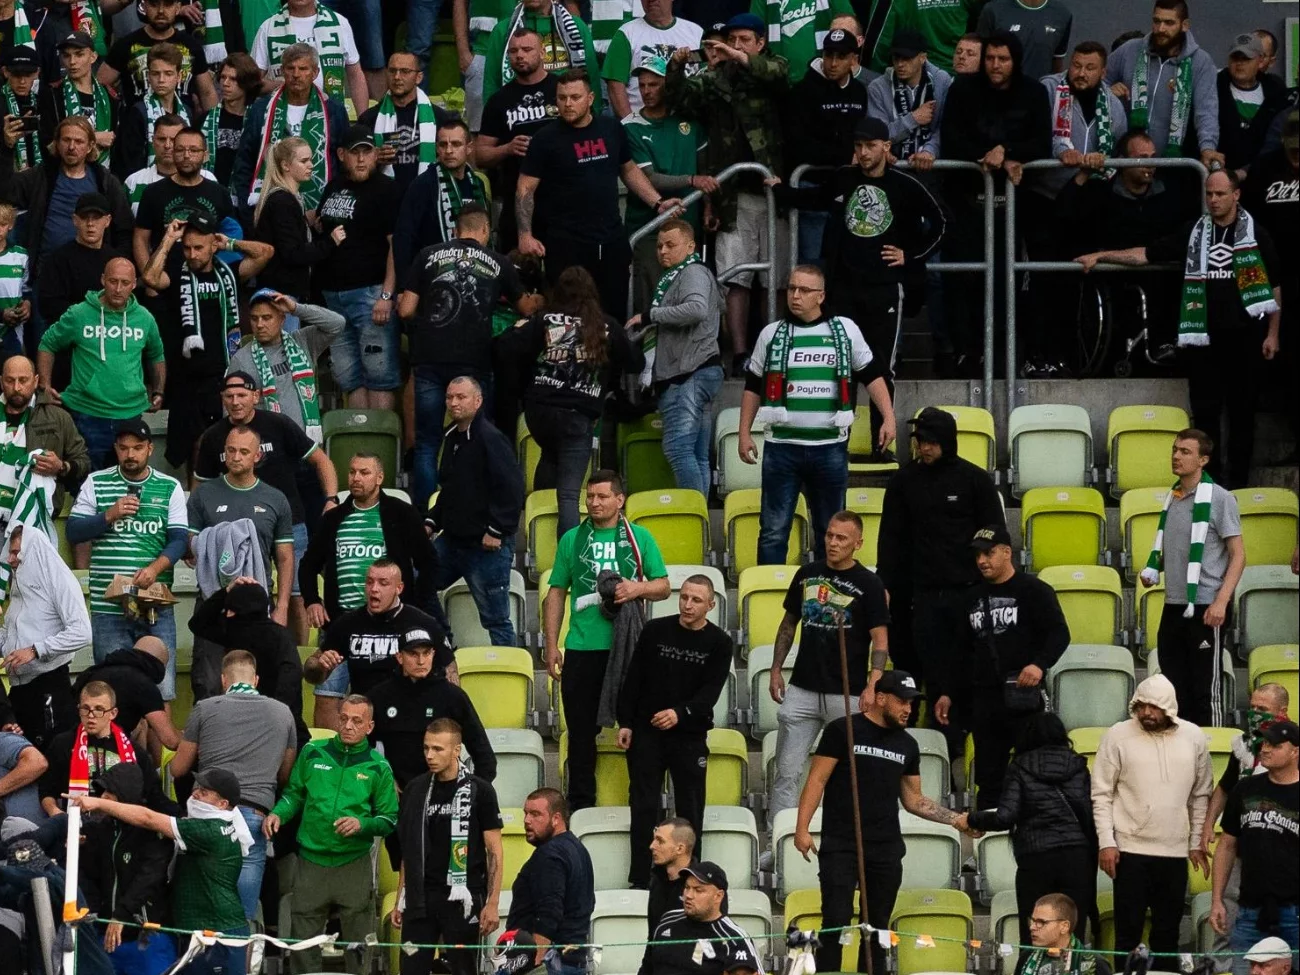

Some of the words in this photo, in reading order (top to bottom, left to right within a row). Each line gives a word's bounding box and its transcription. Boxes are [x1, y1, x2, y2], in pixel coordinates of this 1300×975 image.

[83, 325, 144, 340] CROPP
[793, 351, 835, 364] Energ
[796, 385, 831, 397] Paytren
